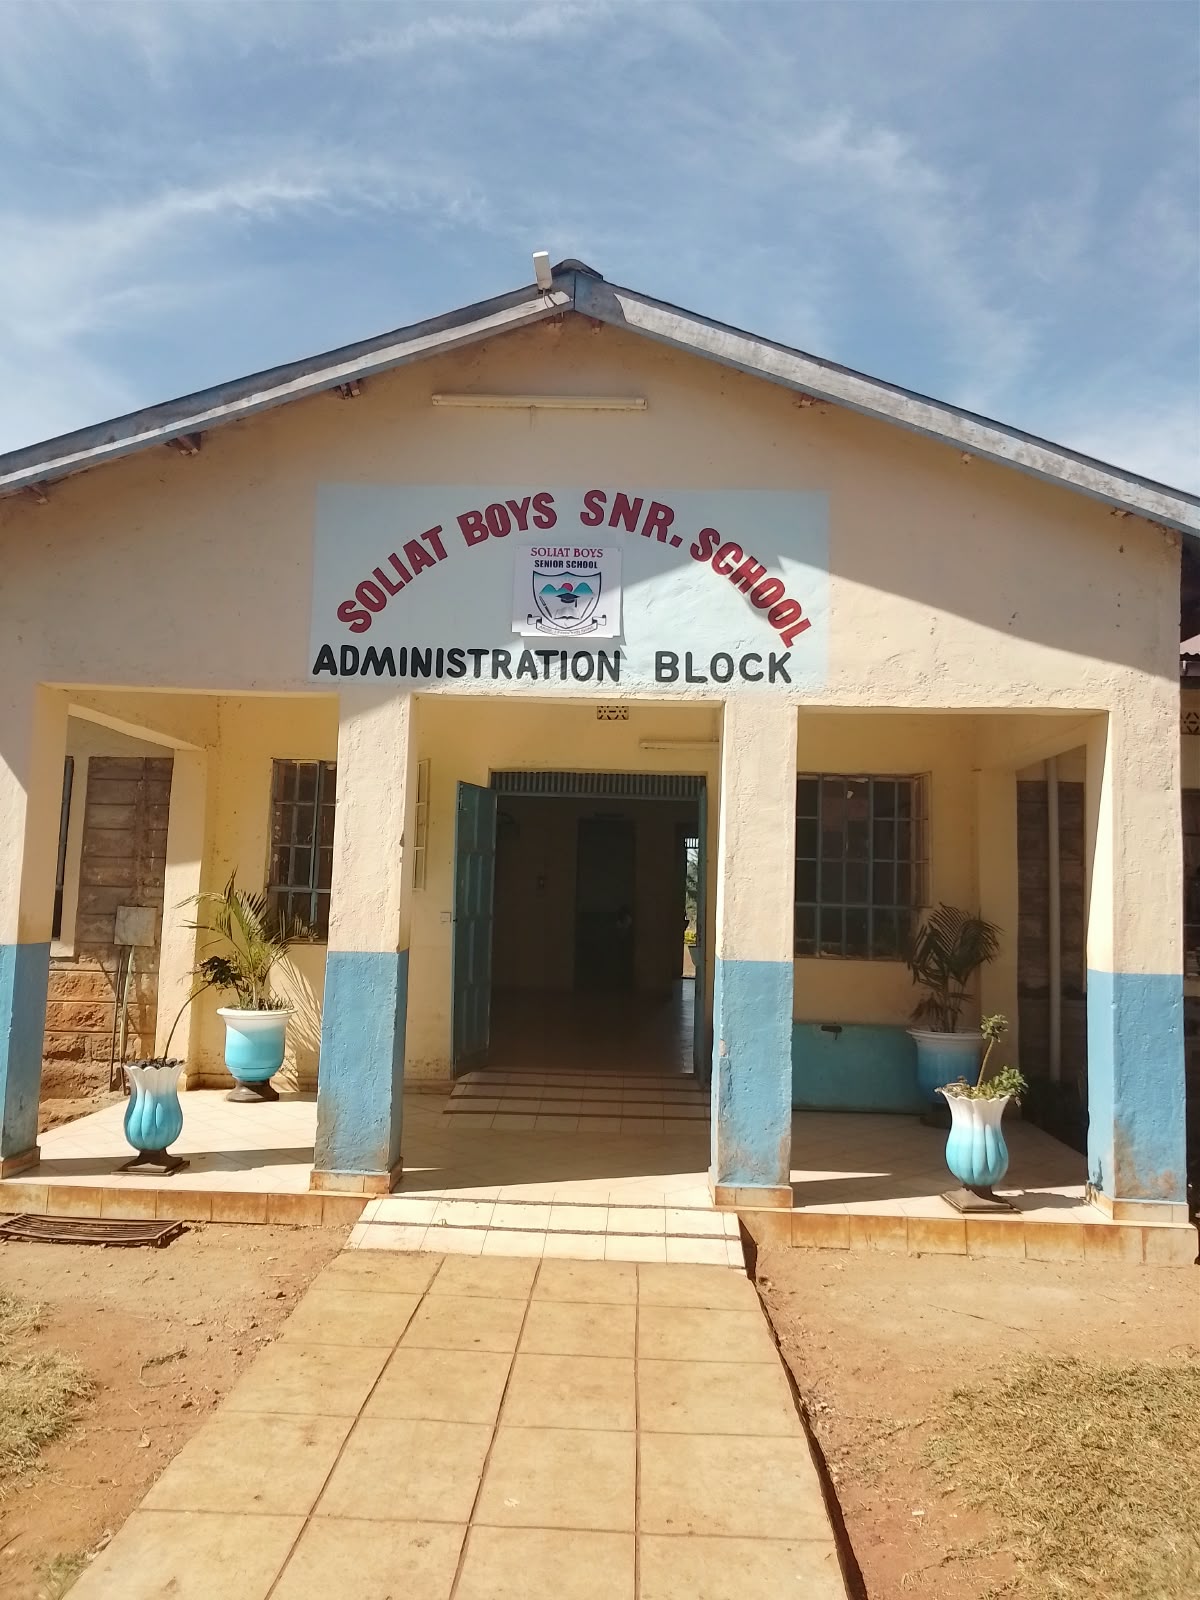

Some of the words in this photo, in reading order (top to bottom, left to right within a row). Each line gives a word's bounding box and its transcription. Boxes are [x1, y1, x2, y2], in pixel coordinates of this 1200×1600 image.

[530, 547, 570, 557] SOLIAT
[574, 548, 603, 557] BOYS
[534, 560, 564, 568] SENIOR
[566, 560, 598, 568] SCHOOL
[337, 525, 448, 633] SOLIAT
[456, 492, 558, 547] BOYS
[579, 490, 683, 548] SNR.
[690, 527, 812, 648] SCHOOL
[313, 644, 621, 683] ADMINISTRATION
[654, 651, 792, 684] BLOCK
